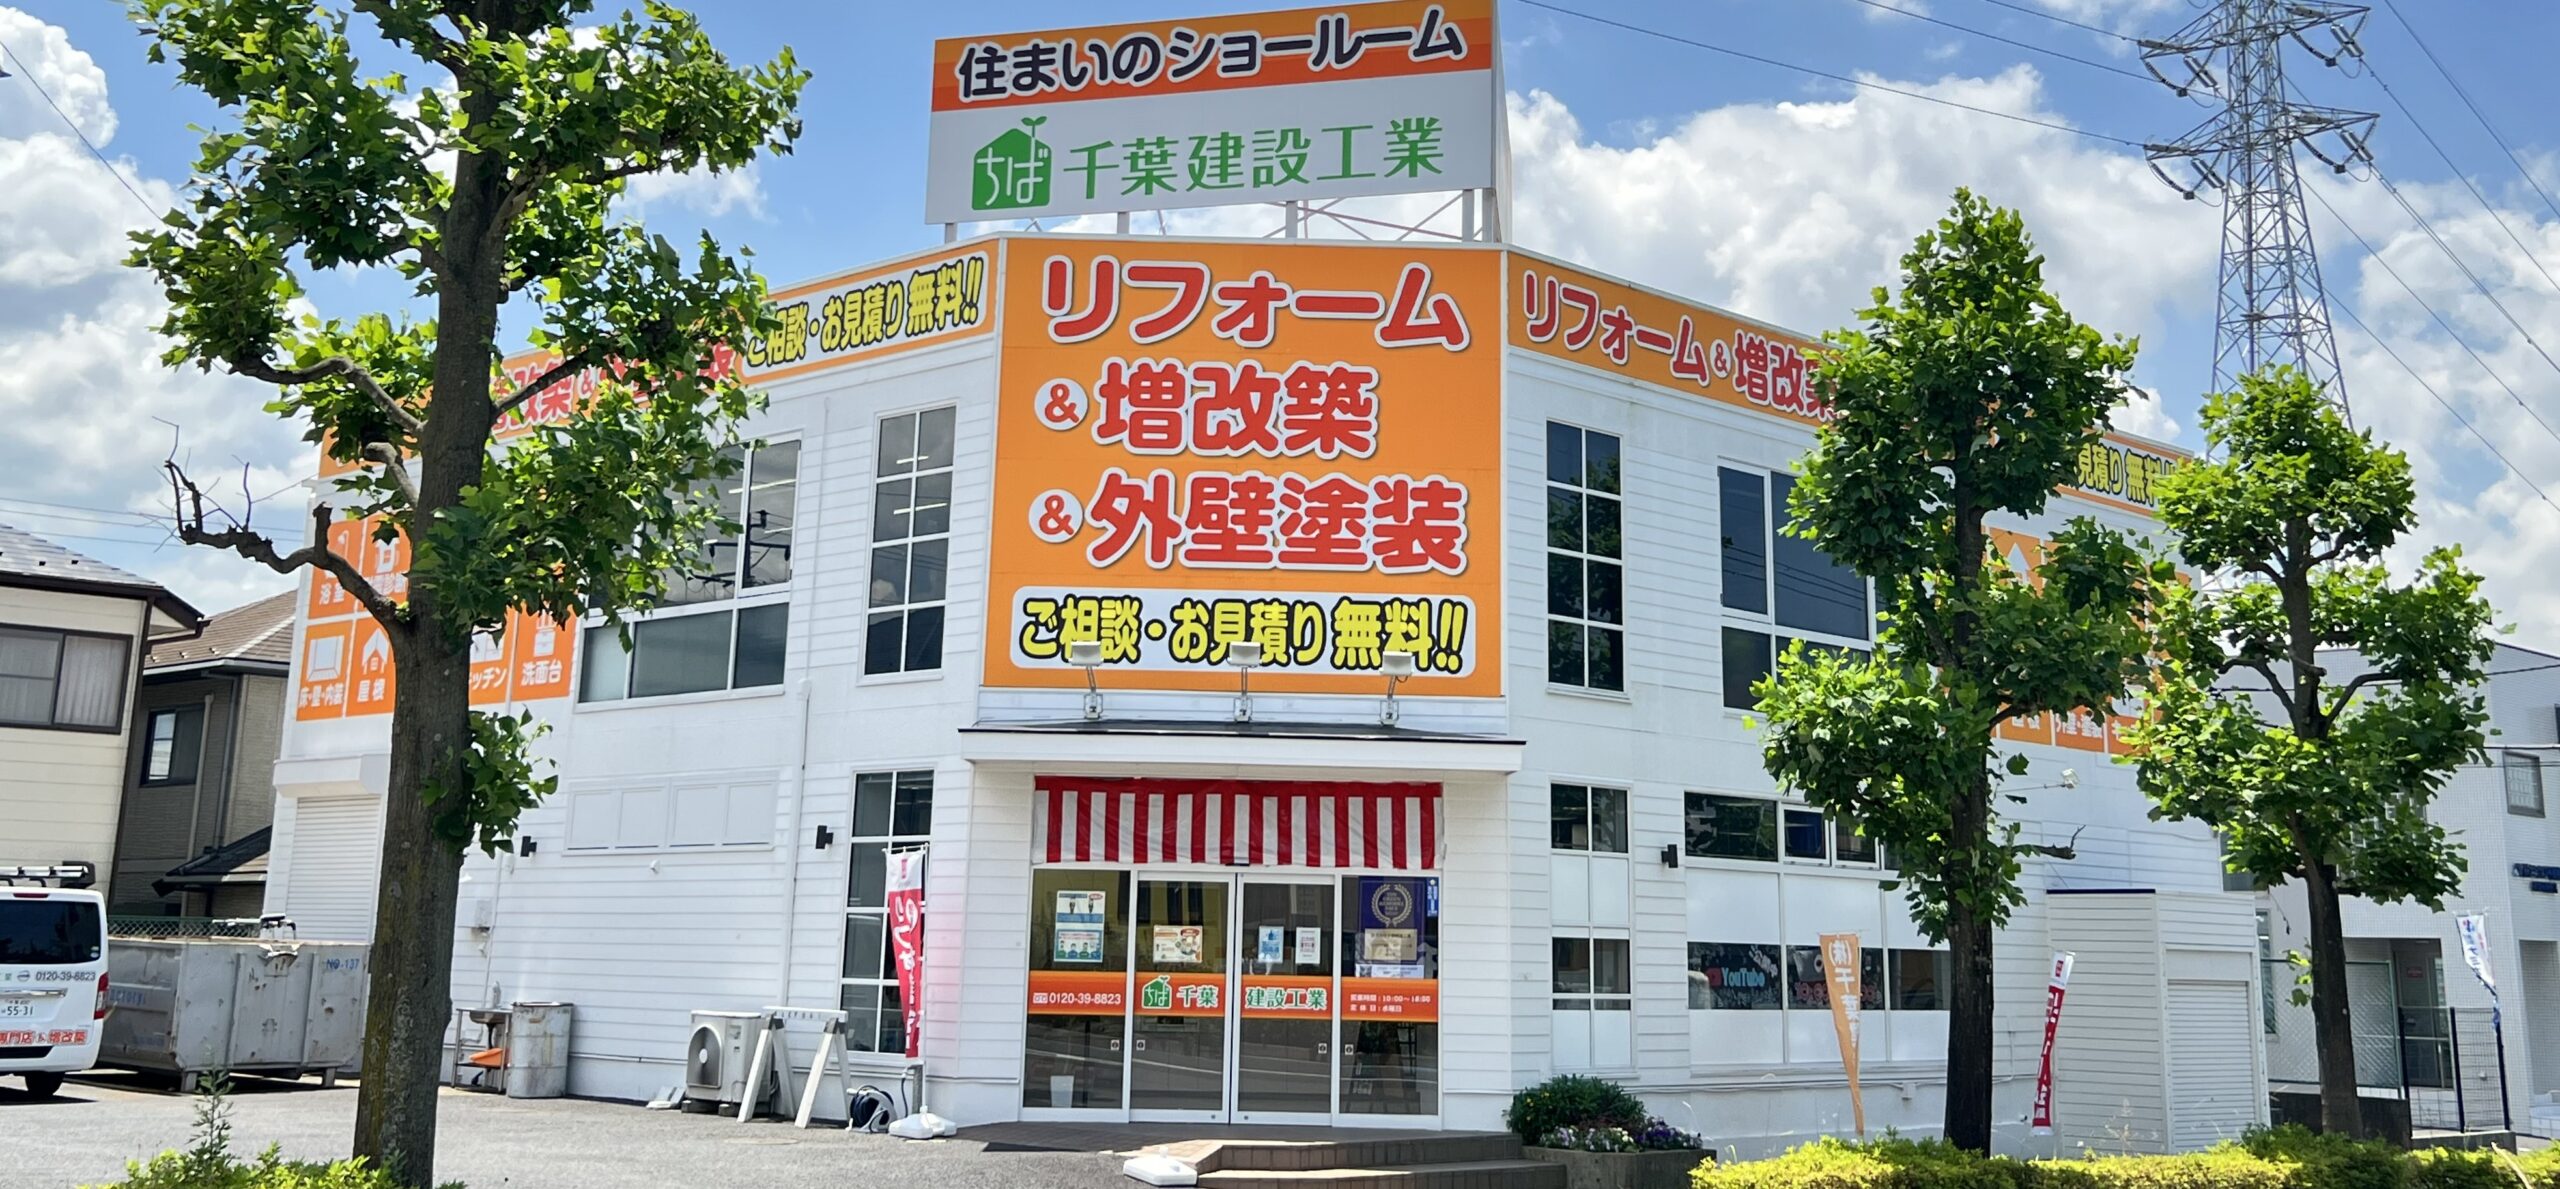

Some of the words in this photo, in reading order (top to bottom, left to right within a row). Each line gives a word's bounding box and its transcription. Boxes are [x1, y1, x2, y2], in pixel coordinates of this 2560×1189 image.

[957, 5, 1466, 101] 住まいのショールーム
[1063, 116, 1443, 200] 千葉建設工業
[1043, 255, 1470, 350] リフォーム
[1524, 270, 1709, 388] リフォーム
[1040, 381, 1082, 426] &
[1095, 358, 1379, 459] 増改築
[1037, 493, 1078, 537] &
[1088, 467, 1468, 574] 外壁塗装
[1020, 595, 1327, 666] ご相談・お見積り
[469, 666, 507, 690] ッチン
[521, 658, 563, 686] 洗面台
[1048, 992, 1121, 1005] 0120-39-8823
[1177, 984, 1219, 1009] 千葉
[1245, 986, 1328, 1011] 建設工業
[1722, 967, 1766, 988] YouTube
